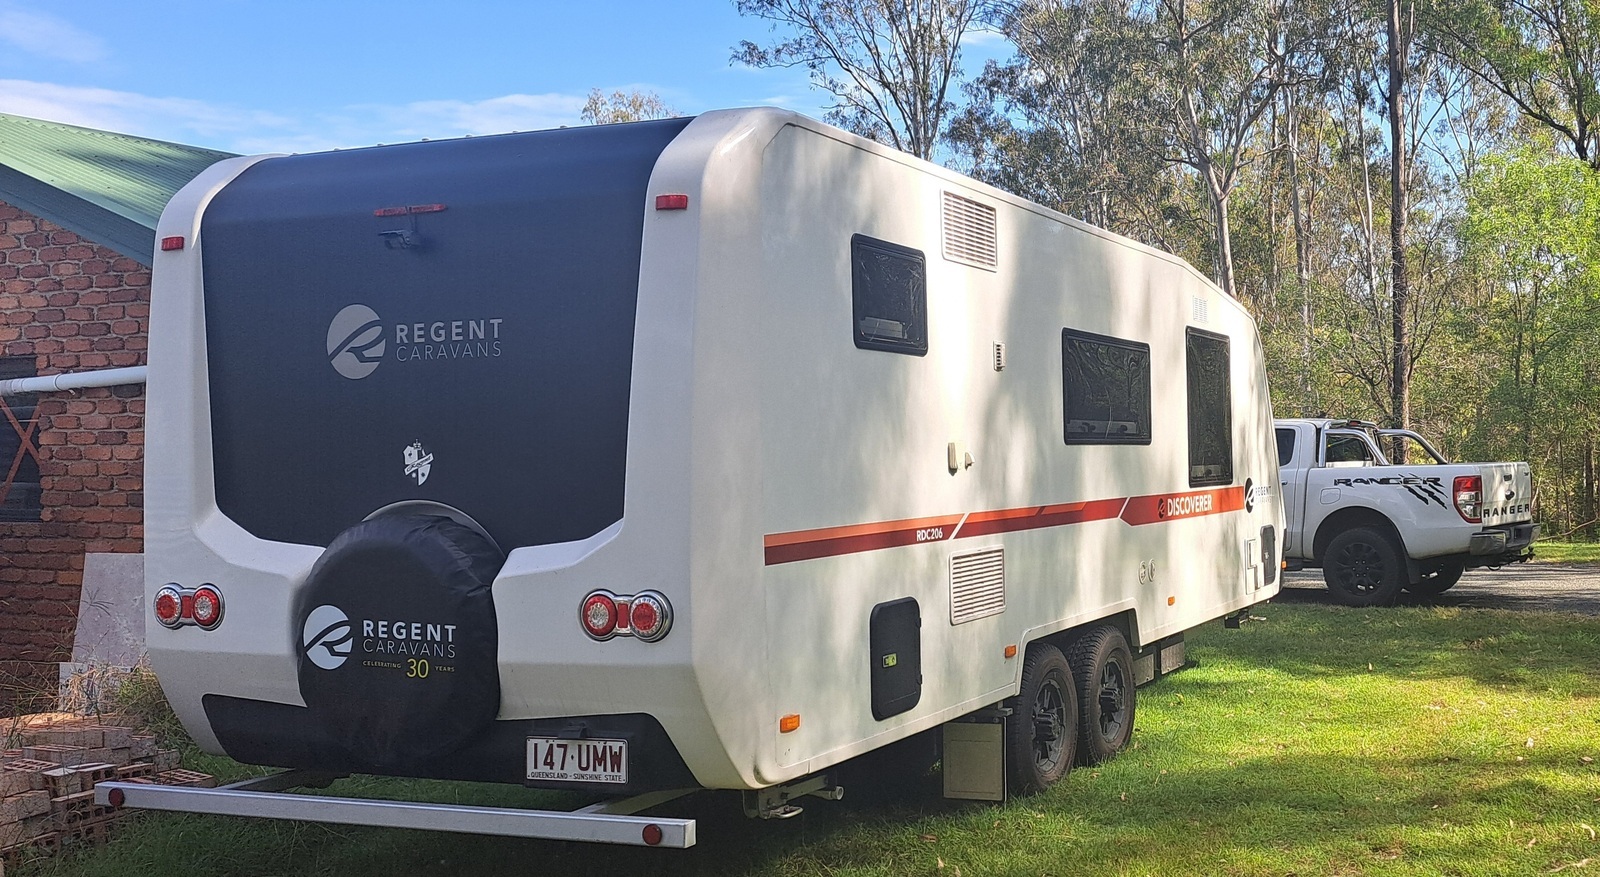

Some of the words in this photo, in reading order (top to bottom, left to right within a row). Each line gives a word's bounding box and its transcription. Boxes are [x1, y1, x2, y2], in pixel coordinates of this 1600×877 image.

[395, 318, 503, 344] REGENT
[396, 341, 502, 361] CARAVANS
[1334, 475, 1443, 488] RANGER
[1167, 494, 1213, 517] DISCOVERER
[1483, 503, 1530, 519] RANGER
[916, 527, 943, 542] RDC206
[363, 619, 457, 643] REGENT
[362, 639, 456, 658] CARAVANS
[362, 660, 402, 669] CELEBRATING
[406, 658, 429, 678] 30
[530, 771, 568, 780] QUEENSLAND
[604, 774, 622, 782] STATE
